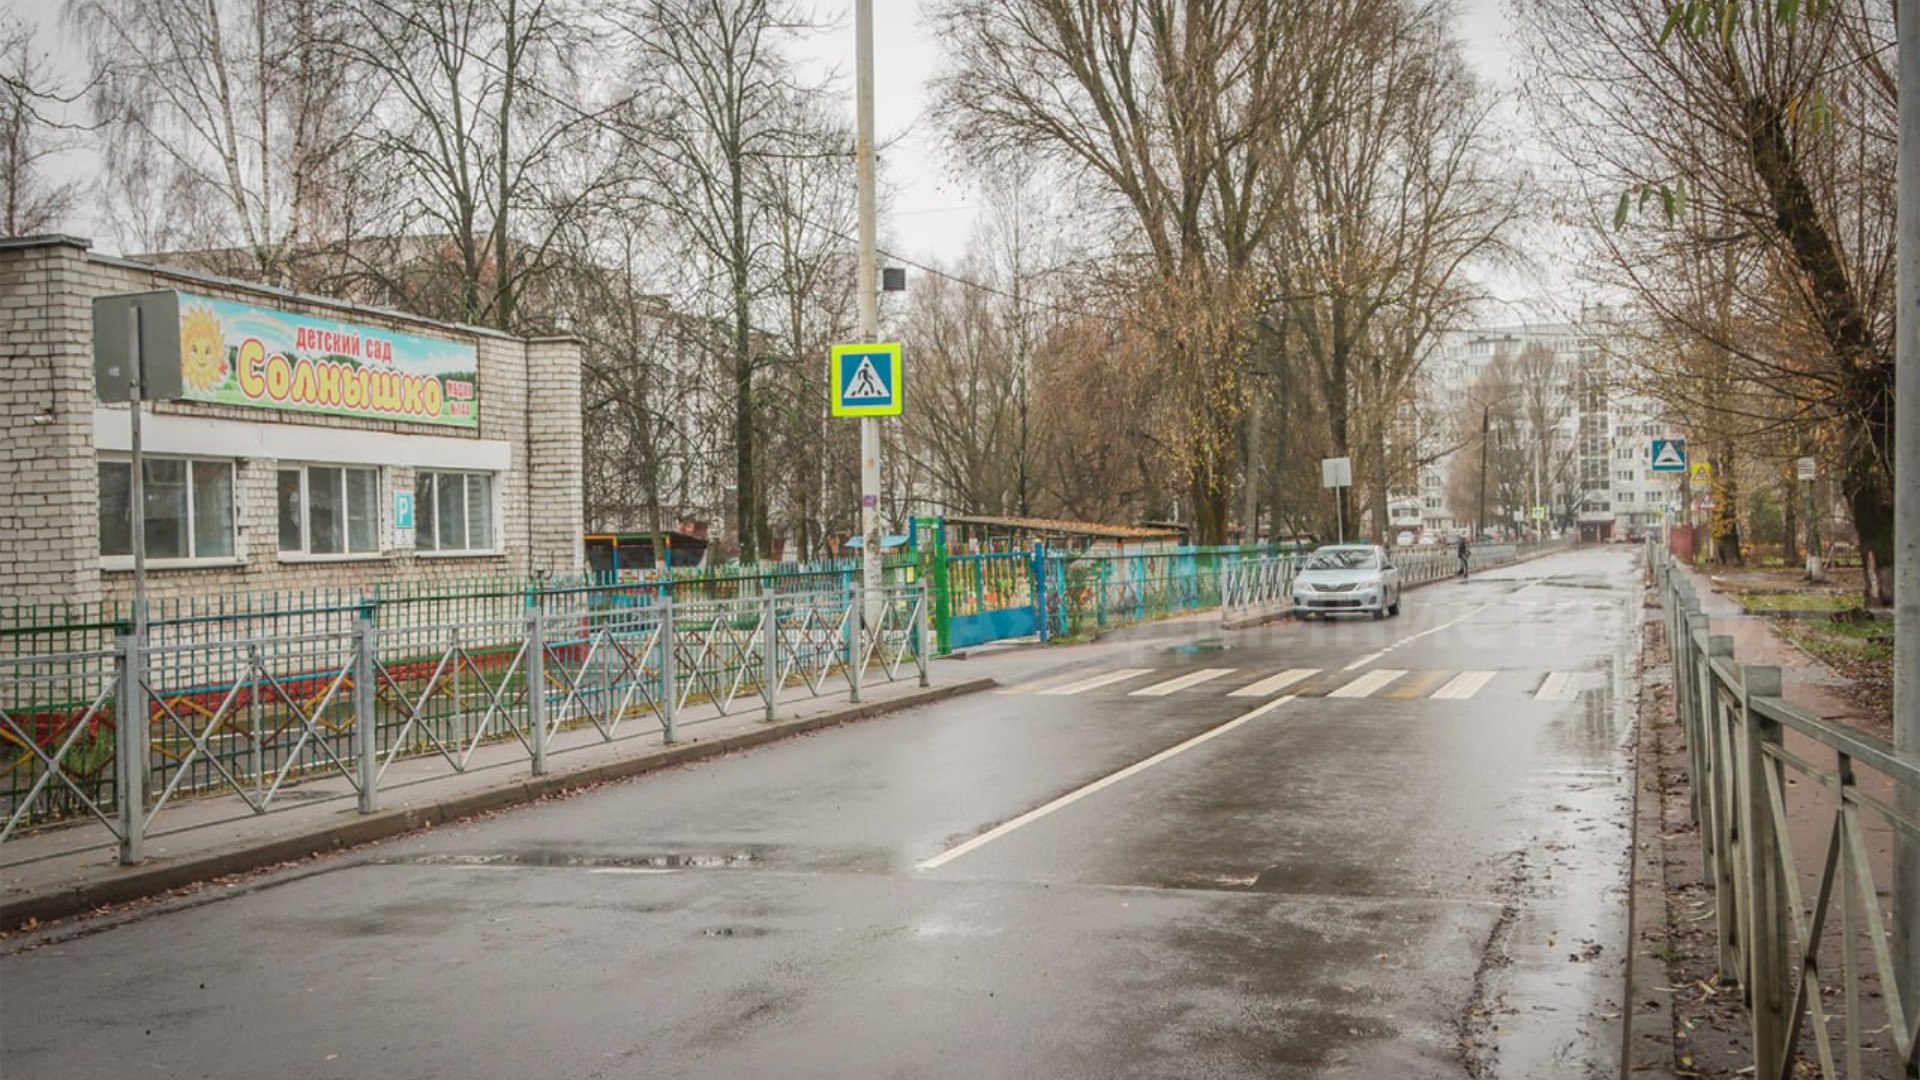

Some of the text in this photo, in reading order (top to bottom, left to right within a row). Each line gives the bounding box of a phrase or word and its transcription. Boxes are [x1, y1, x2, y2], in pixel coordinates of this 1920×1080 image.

[365, 338, 392, 363] сад
[238, 338, 443, 417] Солнышко
[399, 497, 409, 525] P
